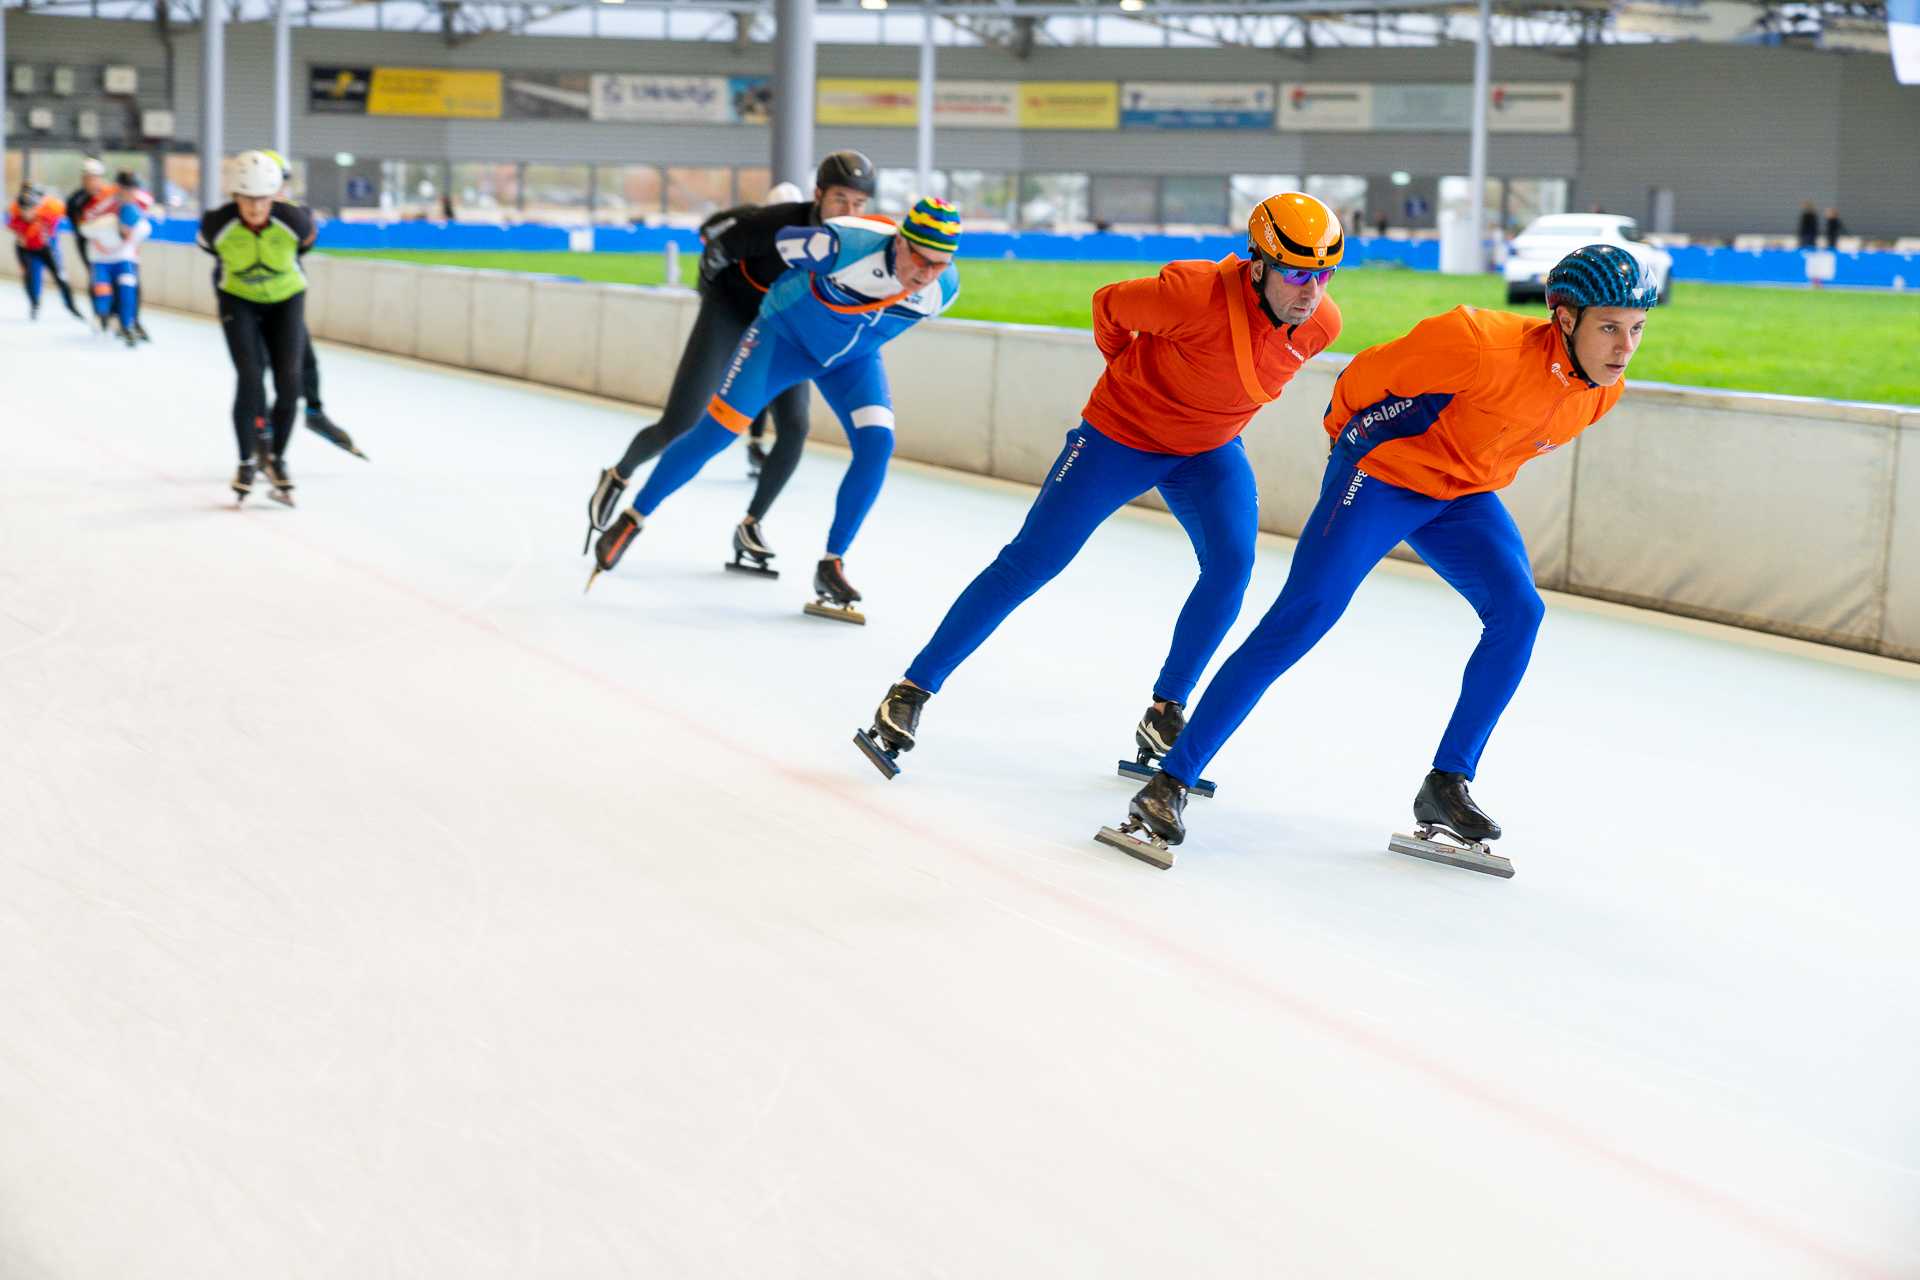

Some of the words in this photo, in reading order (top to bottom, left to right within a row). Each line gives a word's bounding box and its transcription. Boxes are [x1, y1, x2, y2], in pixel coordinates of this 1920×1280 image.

[1362, 399, 1413, 427] Balans
[1056, 450, 1079, 482] Balans
[1343, 469, 1368, 506] Balans
